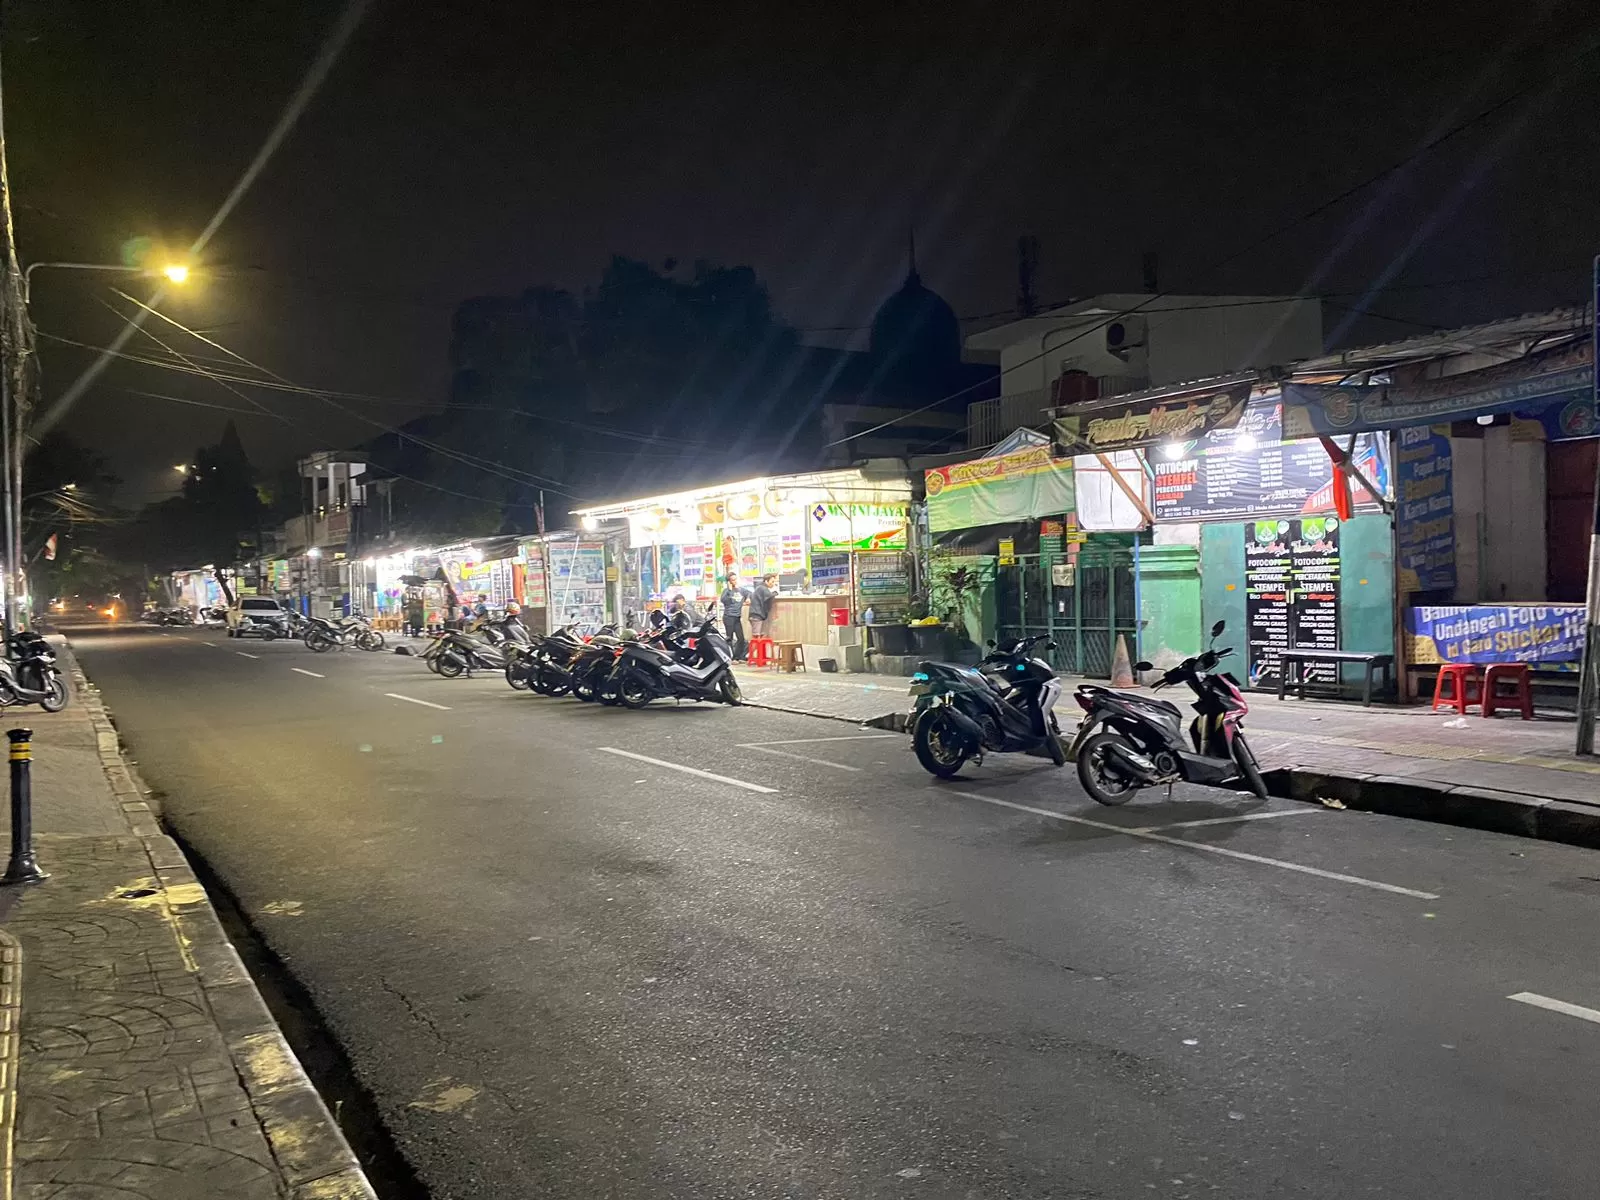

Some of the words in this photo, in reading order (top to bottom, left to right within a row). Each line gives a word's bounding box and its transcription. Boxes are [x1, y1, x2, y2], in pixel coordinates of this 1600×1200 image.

[1156, 460, 1198, 475] FOTOCOPY
[1156, 472, 1197, 487] STEMPEL
[873, 504, 904, 517] JAYA
[1254, 583, 1286, 592] STEMPEL
[1300, 582, 1335, 592] STEMPEL
[1435, 612, 1507, 640] Undangan
[1461, 636, 1492, 656] Card
[1495, 623, 1561, 652] Sticker
